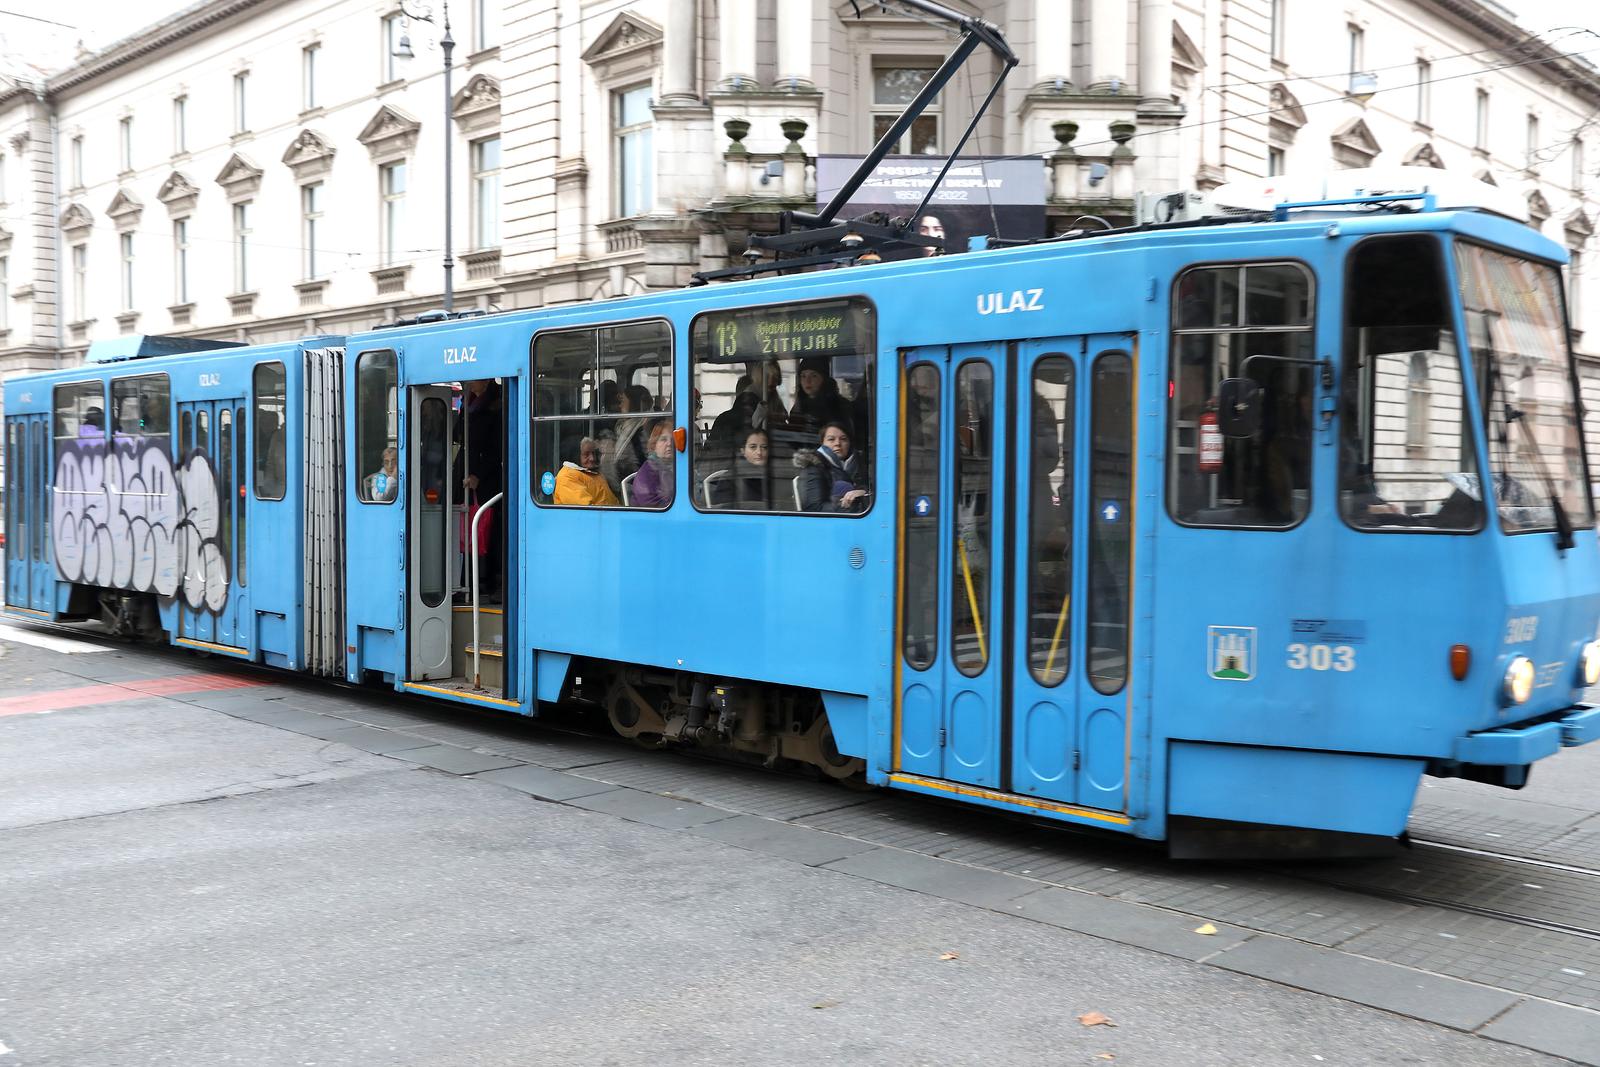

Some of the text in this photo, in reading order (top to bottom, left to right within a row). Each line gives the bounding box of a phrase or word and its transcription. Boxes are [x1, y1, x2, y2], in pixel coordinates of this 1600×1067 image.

[945, 179, 1003, 188] DISPLAY
[937, 190, 968, 200] 2022
[976, 287, 1045, 315] ULAZ
[716, 321, 738, 357] 13
[762, 333, 838, 354] ŽITNJAK
[443, 346, 477, 365] IZLAZ
[199, 373, 221, 387] IZLAZ
[1286, 643, 1356, 672] 303
